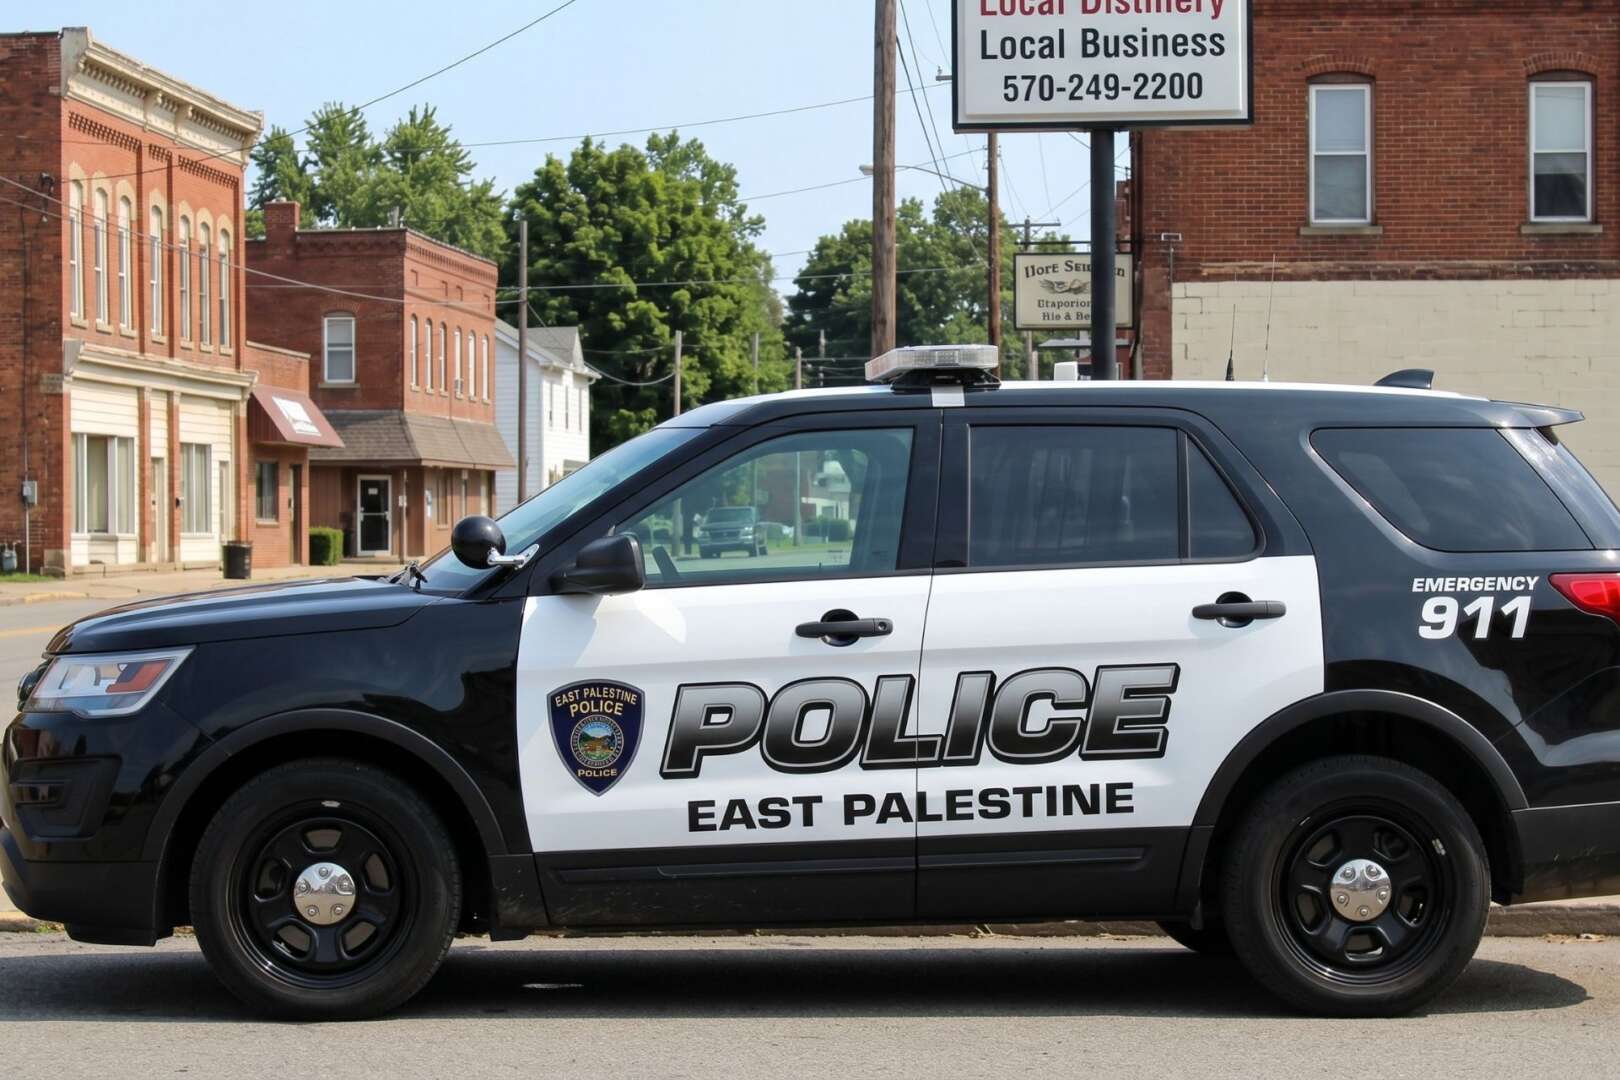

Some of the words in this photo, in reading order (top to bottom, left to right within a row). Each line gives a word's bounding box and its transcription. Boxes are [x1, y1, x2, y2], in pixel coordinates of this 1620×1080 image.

[980, 28, 1065, 60] Local
[1081, 27, 1226, 58] Business
[1003, 72, 1204, 102] 570-249-2200
[1411, 576, 1540, 592] EMERGENCY
[1418, 596, 1532, 640] 911
[555, 689, 580, 707] EAST
[583, 687, 638, 705] PALESTINE
[569, 700, 624, 718] POLICE
[659, 663, 1180, 780] POLICE
[577, 768, 618, 778] POLICE
[688, 795, 823, 832] EAST
[843, 782, 1134, 826] PALESTINE
